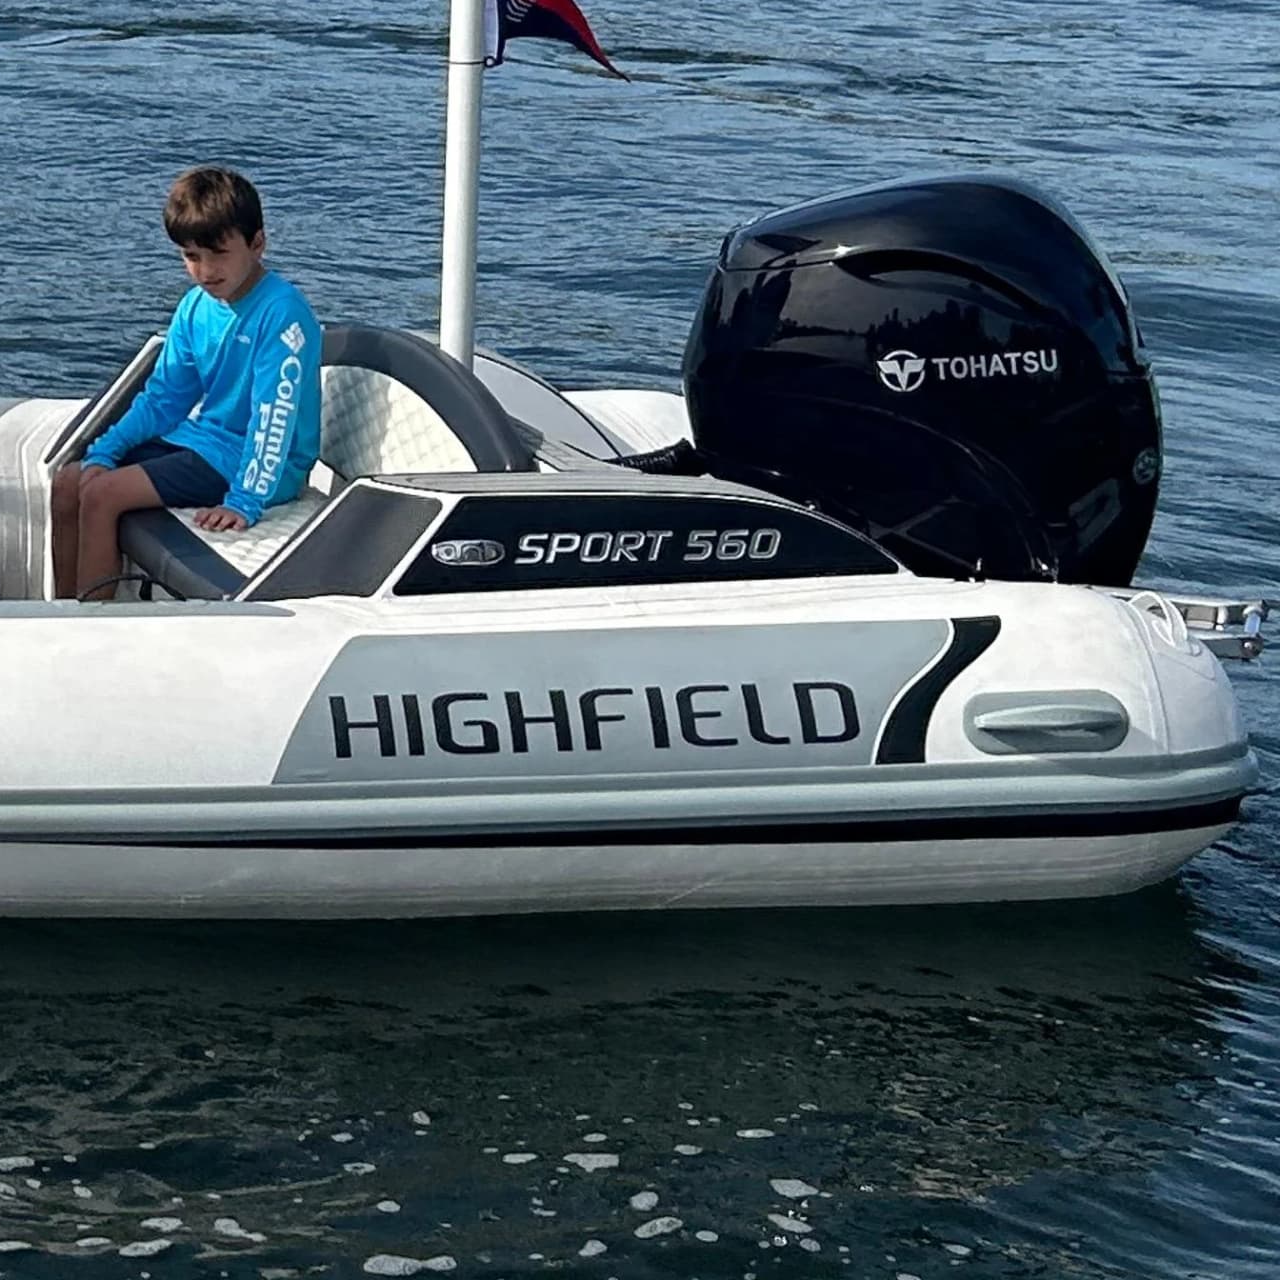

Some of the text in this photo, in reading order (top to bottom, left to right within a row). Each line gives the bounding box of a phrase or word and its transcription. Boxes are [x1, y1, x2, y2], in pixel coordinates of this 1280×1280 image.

[931, 349, 1058, 381] TOHATSU
[242, 402, 272, 490] PFG
[255, 355, 302, 495] Columbia
[514, 528, 782, 565] SPORT 560
[328, 681, 861, 759] HIGHFIELD
